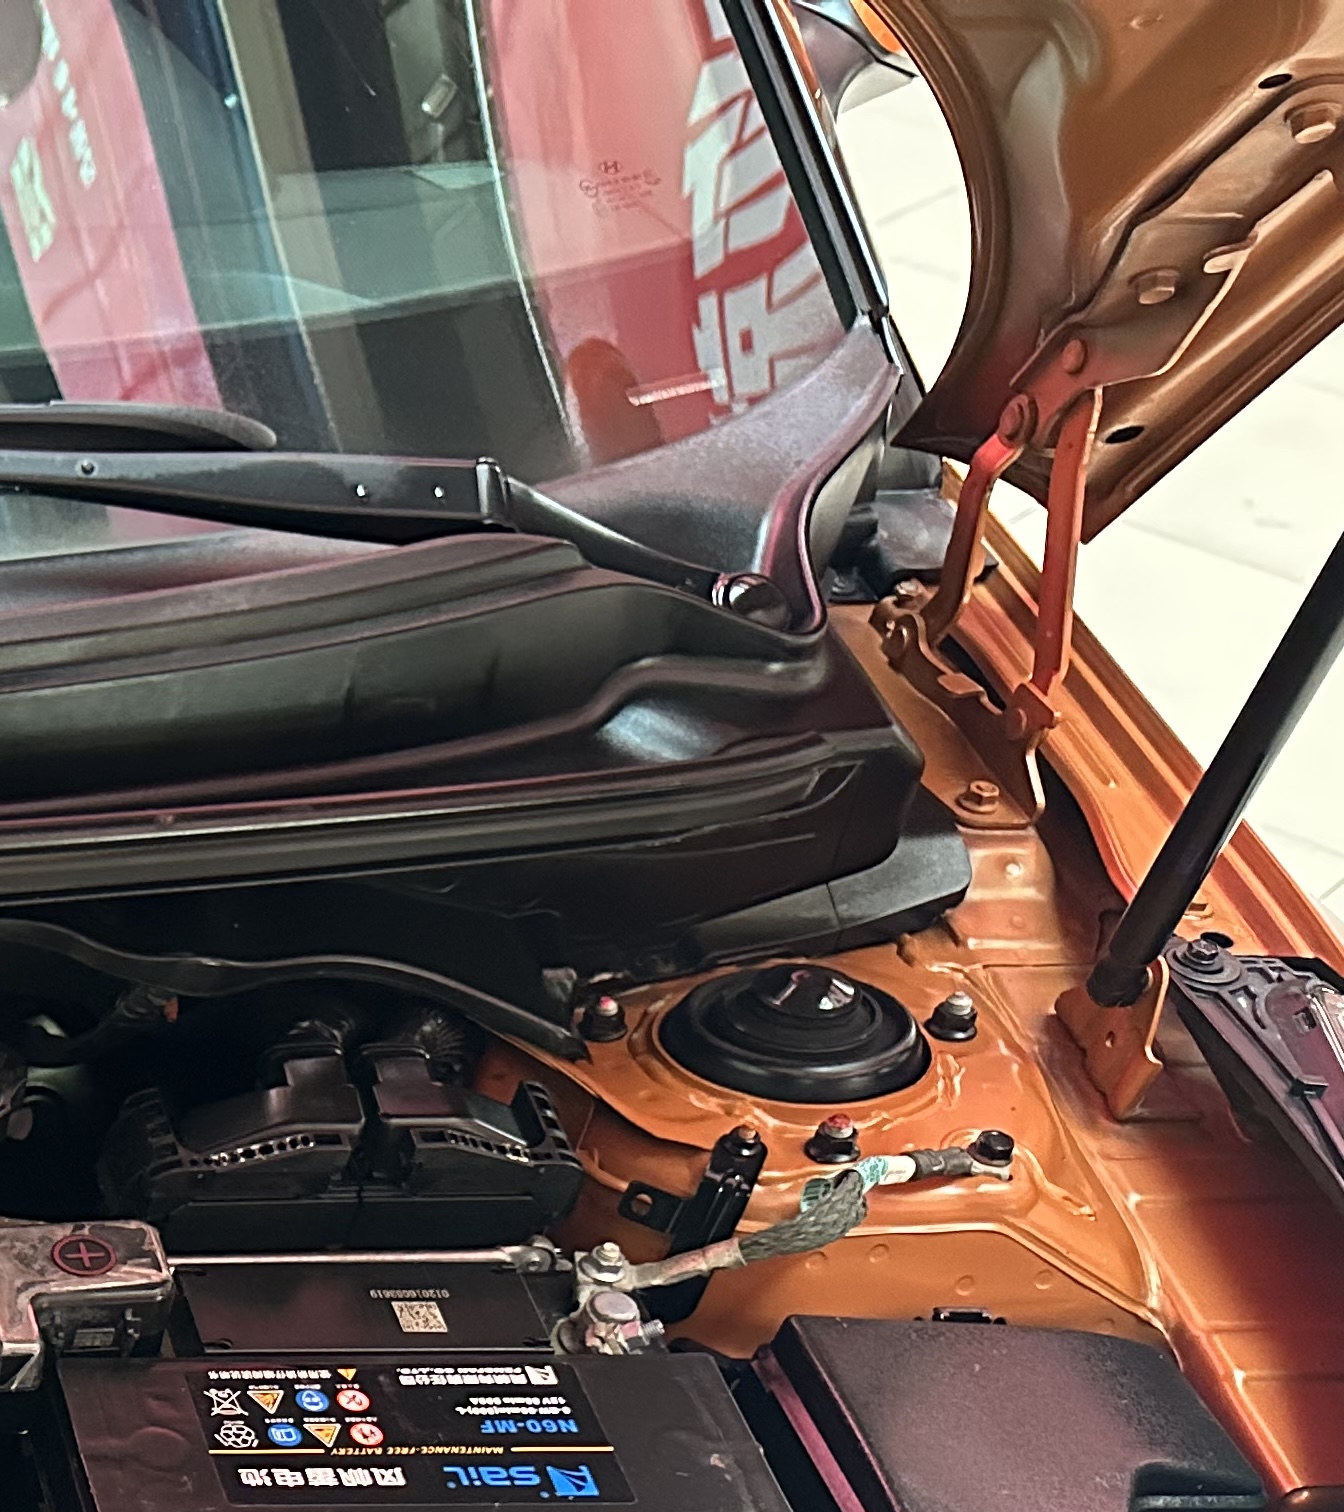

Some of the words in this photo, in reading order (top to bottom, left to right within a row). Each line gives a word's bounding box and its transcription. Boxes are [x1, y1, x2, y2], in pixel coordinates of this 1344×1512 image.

[480, 1419, 579, 1434] N60-MF
[330, 1447, 382, 1457] BATTERY
[237, 1466, 408, 1488] 风帆蓄电池
